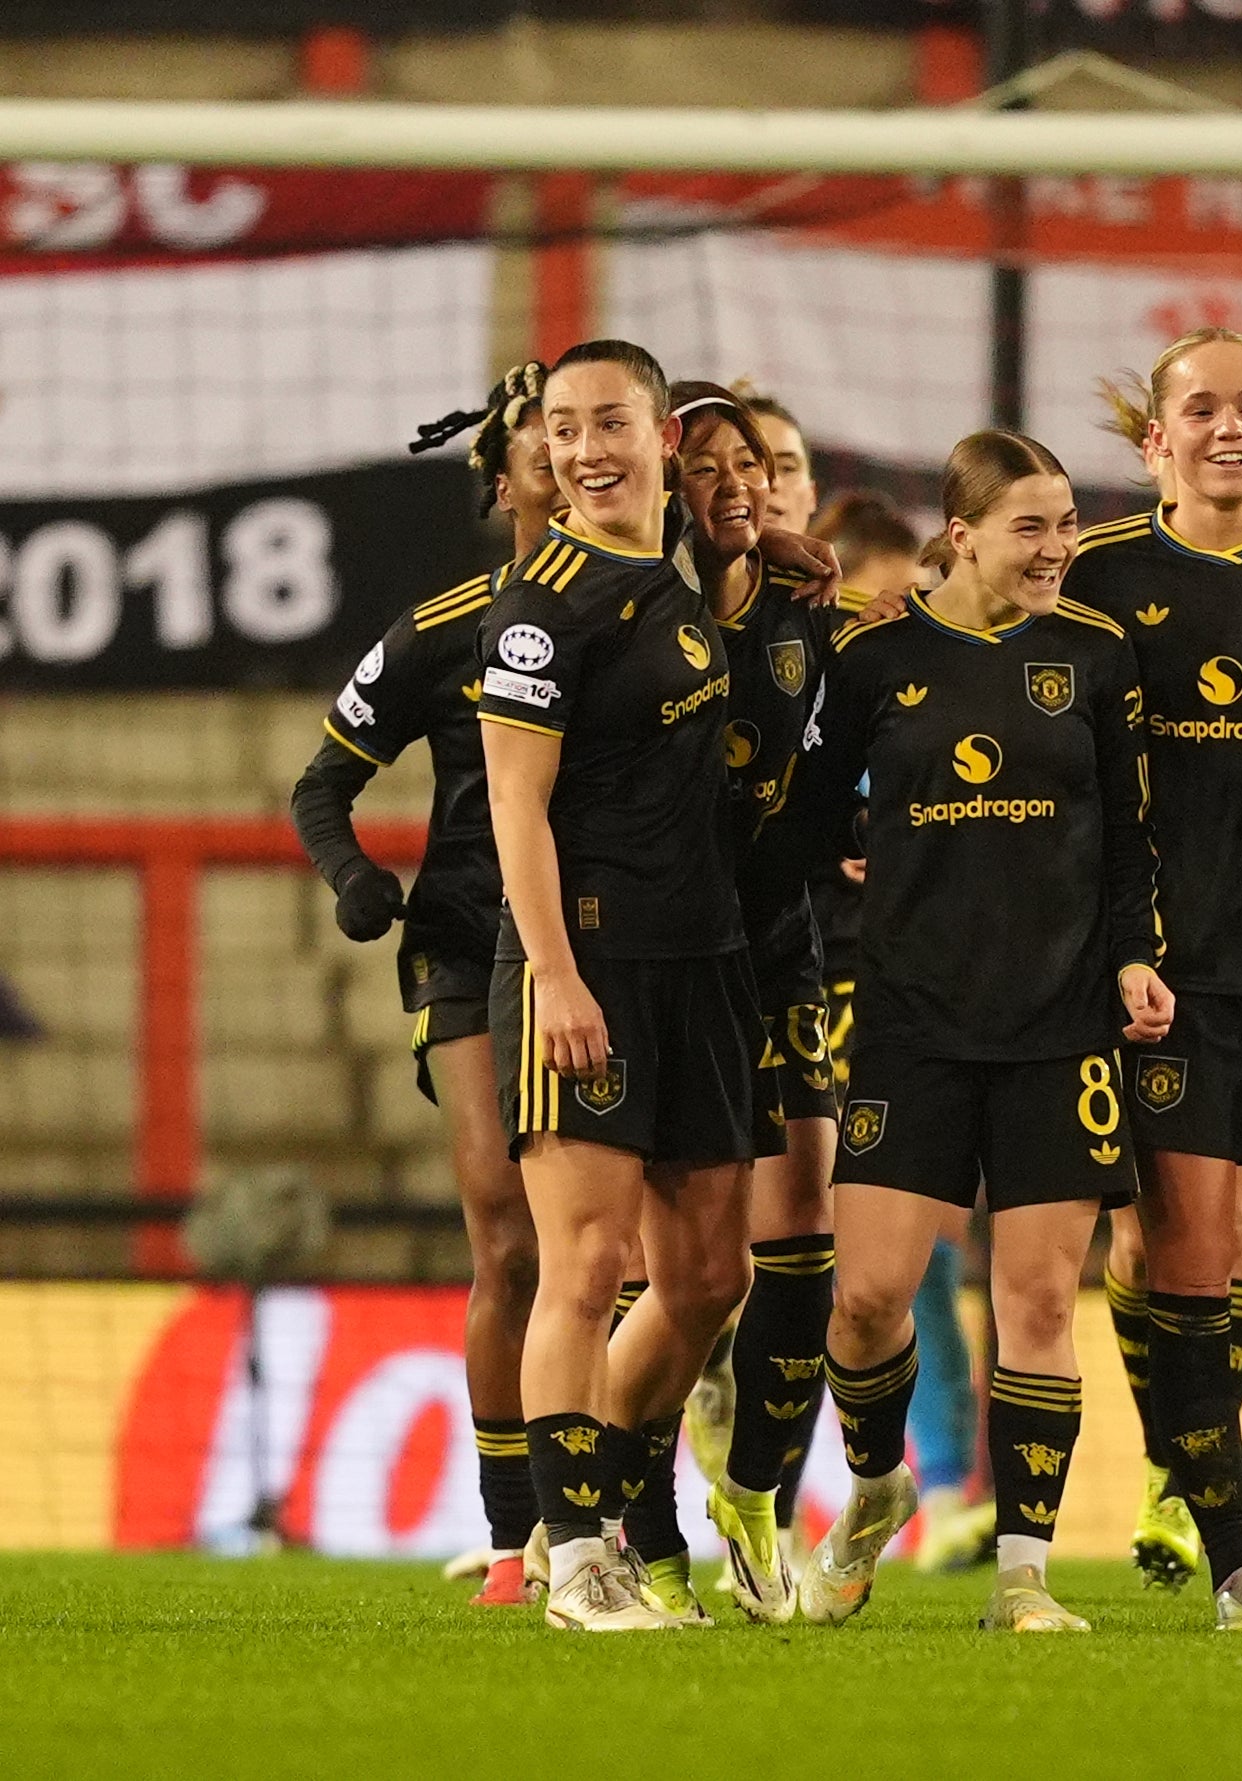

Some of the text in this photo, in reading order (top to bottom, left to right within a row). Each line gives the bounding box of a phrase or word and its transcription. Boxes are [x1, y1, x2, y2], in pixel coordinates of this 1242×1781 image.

[0, 498, 342, 664] 018
[909, 795, 1055, 827] Snapdragon
[1077, 1053, 1121, 1136] 8
